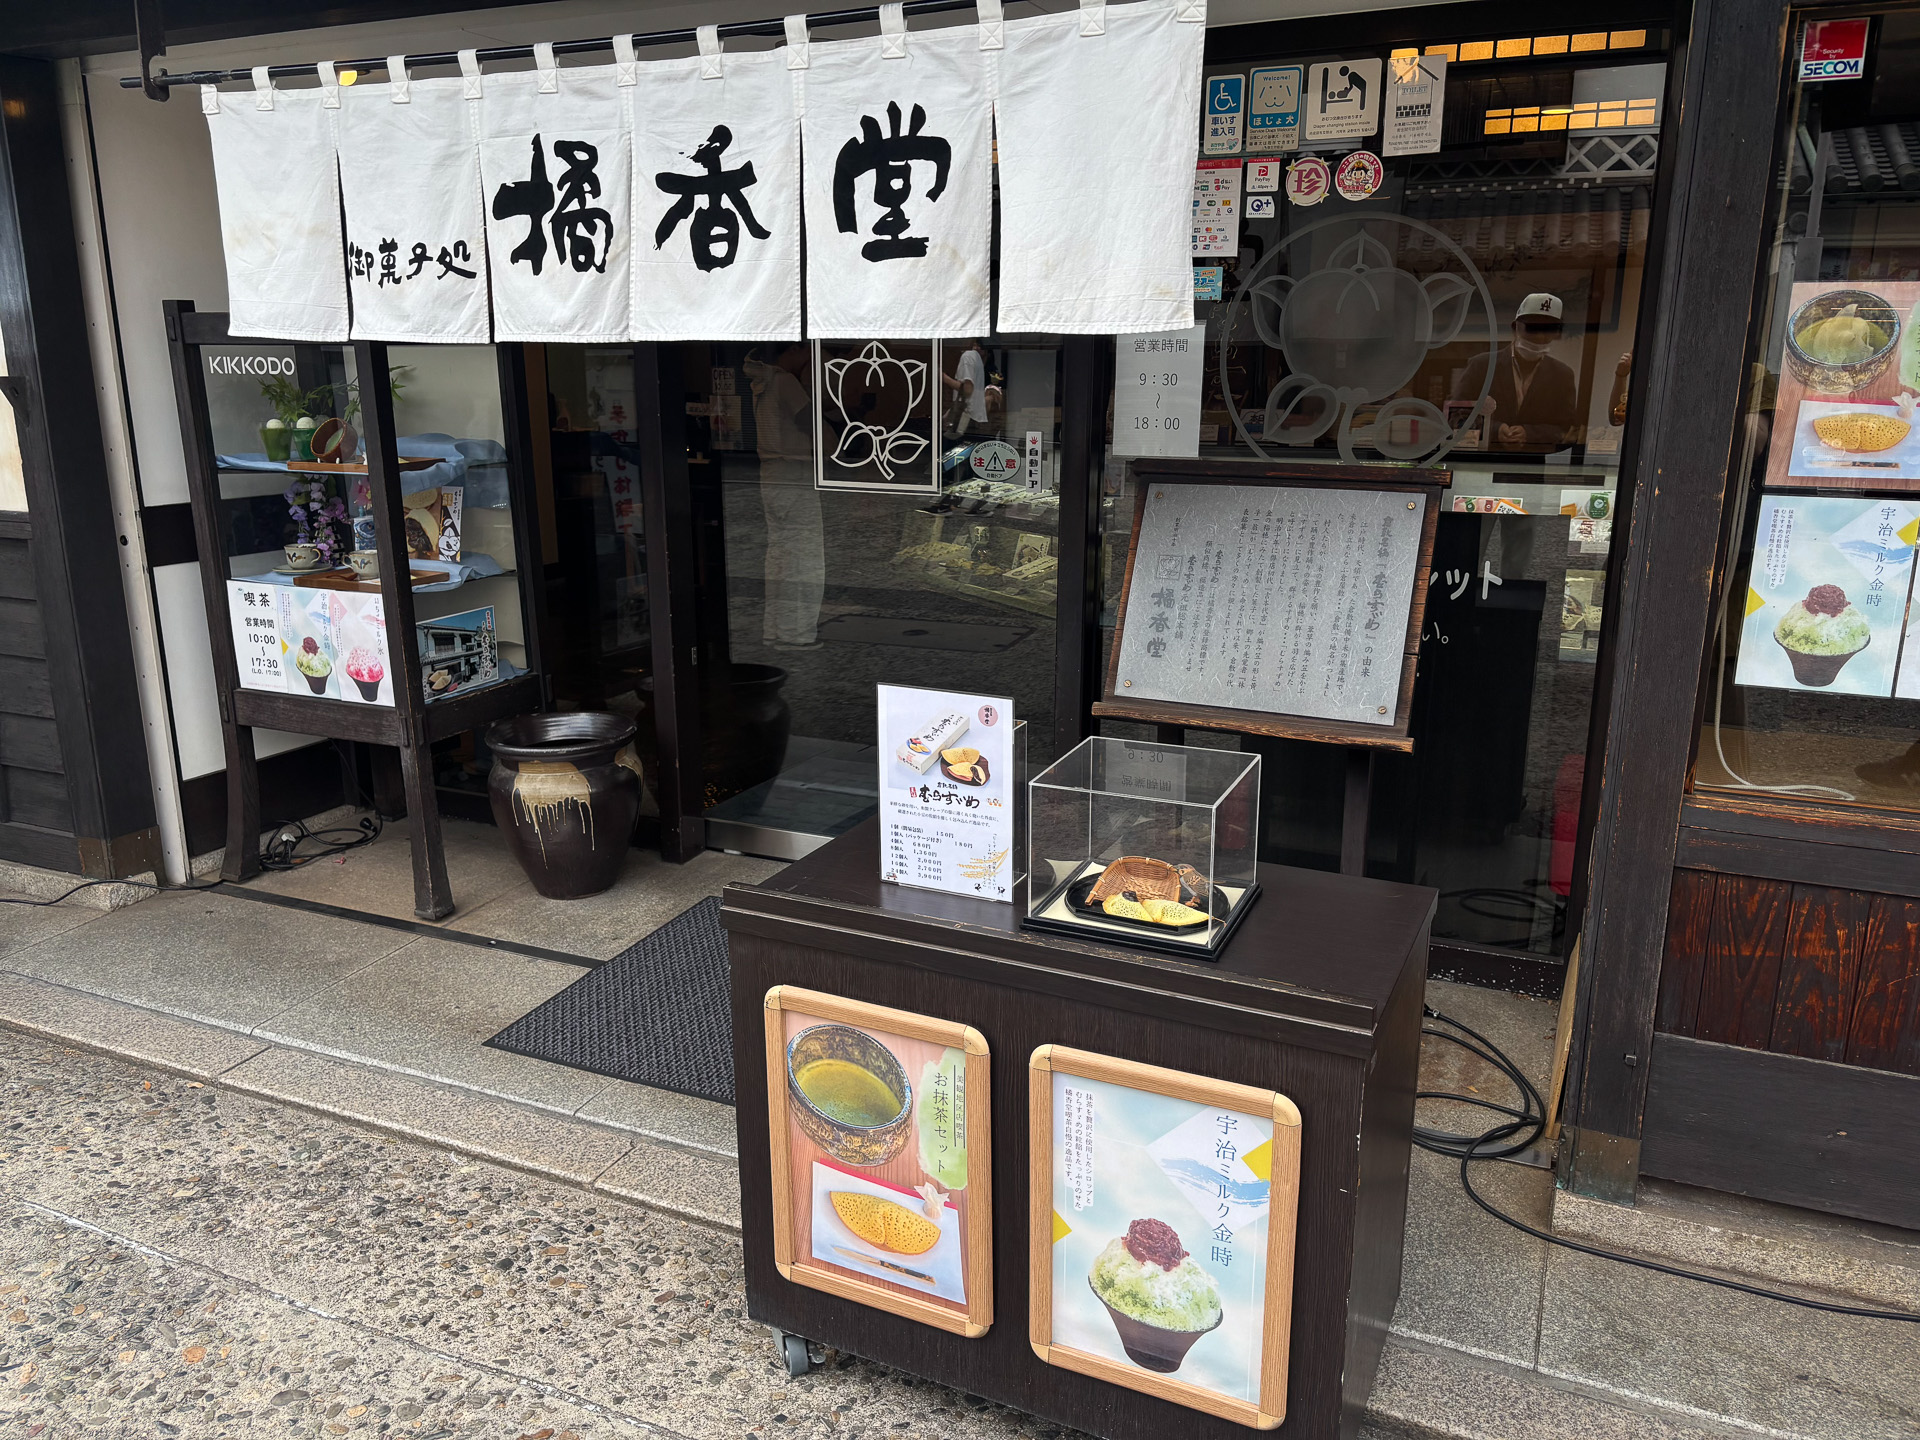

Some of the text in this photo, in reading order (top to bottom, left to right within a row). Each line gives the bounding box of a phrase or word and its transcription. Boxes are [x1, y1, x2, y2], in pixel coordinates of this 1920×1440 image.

[1803, 60, 1859, 76] SECOM
[1401, 85, 1428, 94] TOILET
[1211, 116, 1236, 125] 車いす
[1253, 115, 1294, 126] ほじょ犬
[1211, 127, 1236, 136] 進入可
[492, 100, 952, 276] 橘香堂
[348, 237, 477, 288] 御菓子処
[1134, 338, 1189, 352] 営業時間
[208, 356, 295, 375] KIKKODO
[1139, 373, 1178, 386] 9:30
[1134, 417, 1180, 430] 18:00
[1029, 448, 1038, 488] 自動ドア
[1866, 505, 1896, 608] 宇治ミルク金時
[244, 592, 271, 608] 喫茶
[244, 617, 275, 629] 営業時間
[1147, 586, 1176, 658] 橘香堂
[248, 633, 276, 645] 10:00
[251, 657, 278, 669] 17:30
[933, 1073, 949, 1173] お抹茶セット
[1210, 1114, 1238, 1267] 宇治ミルク金時
